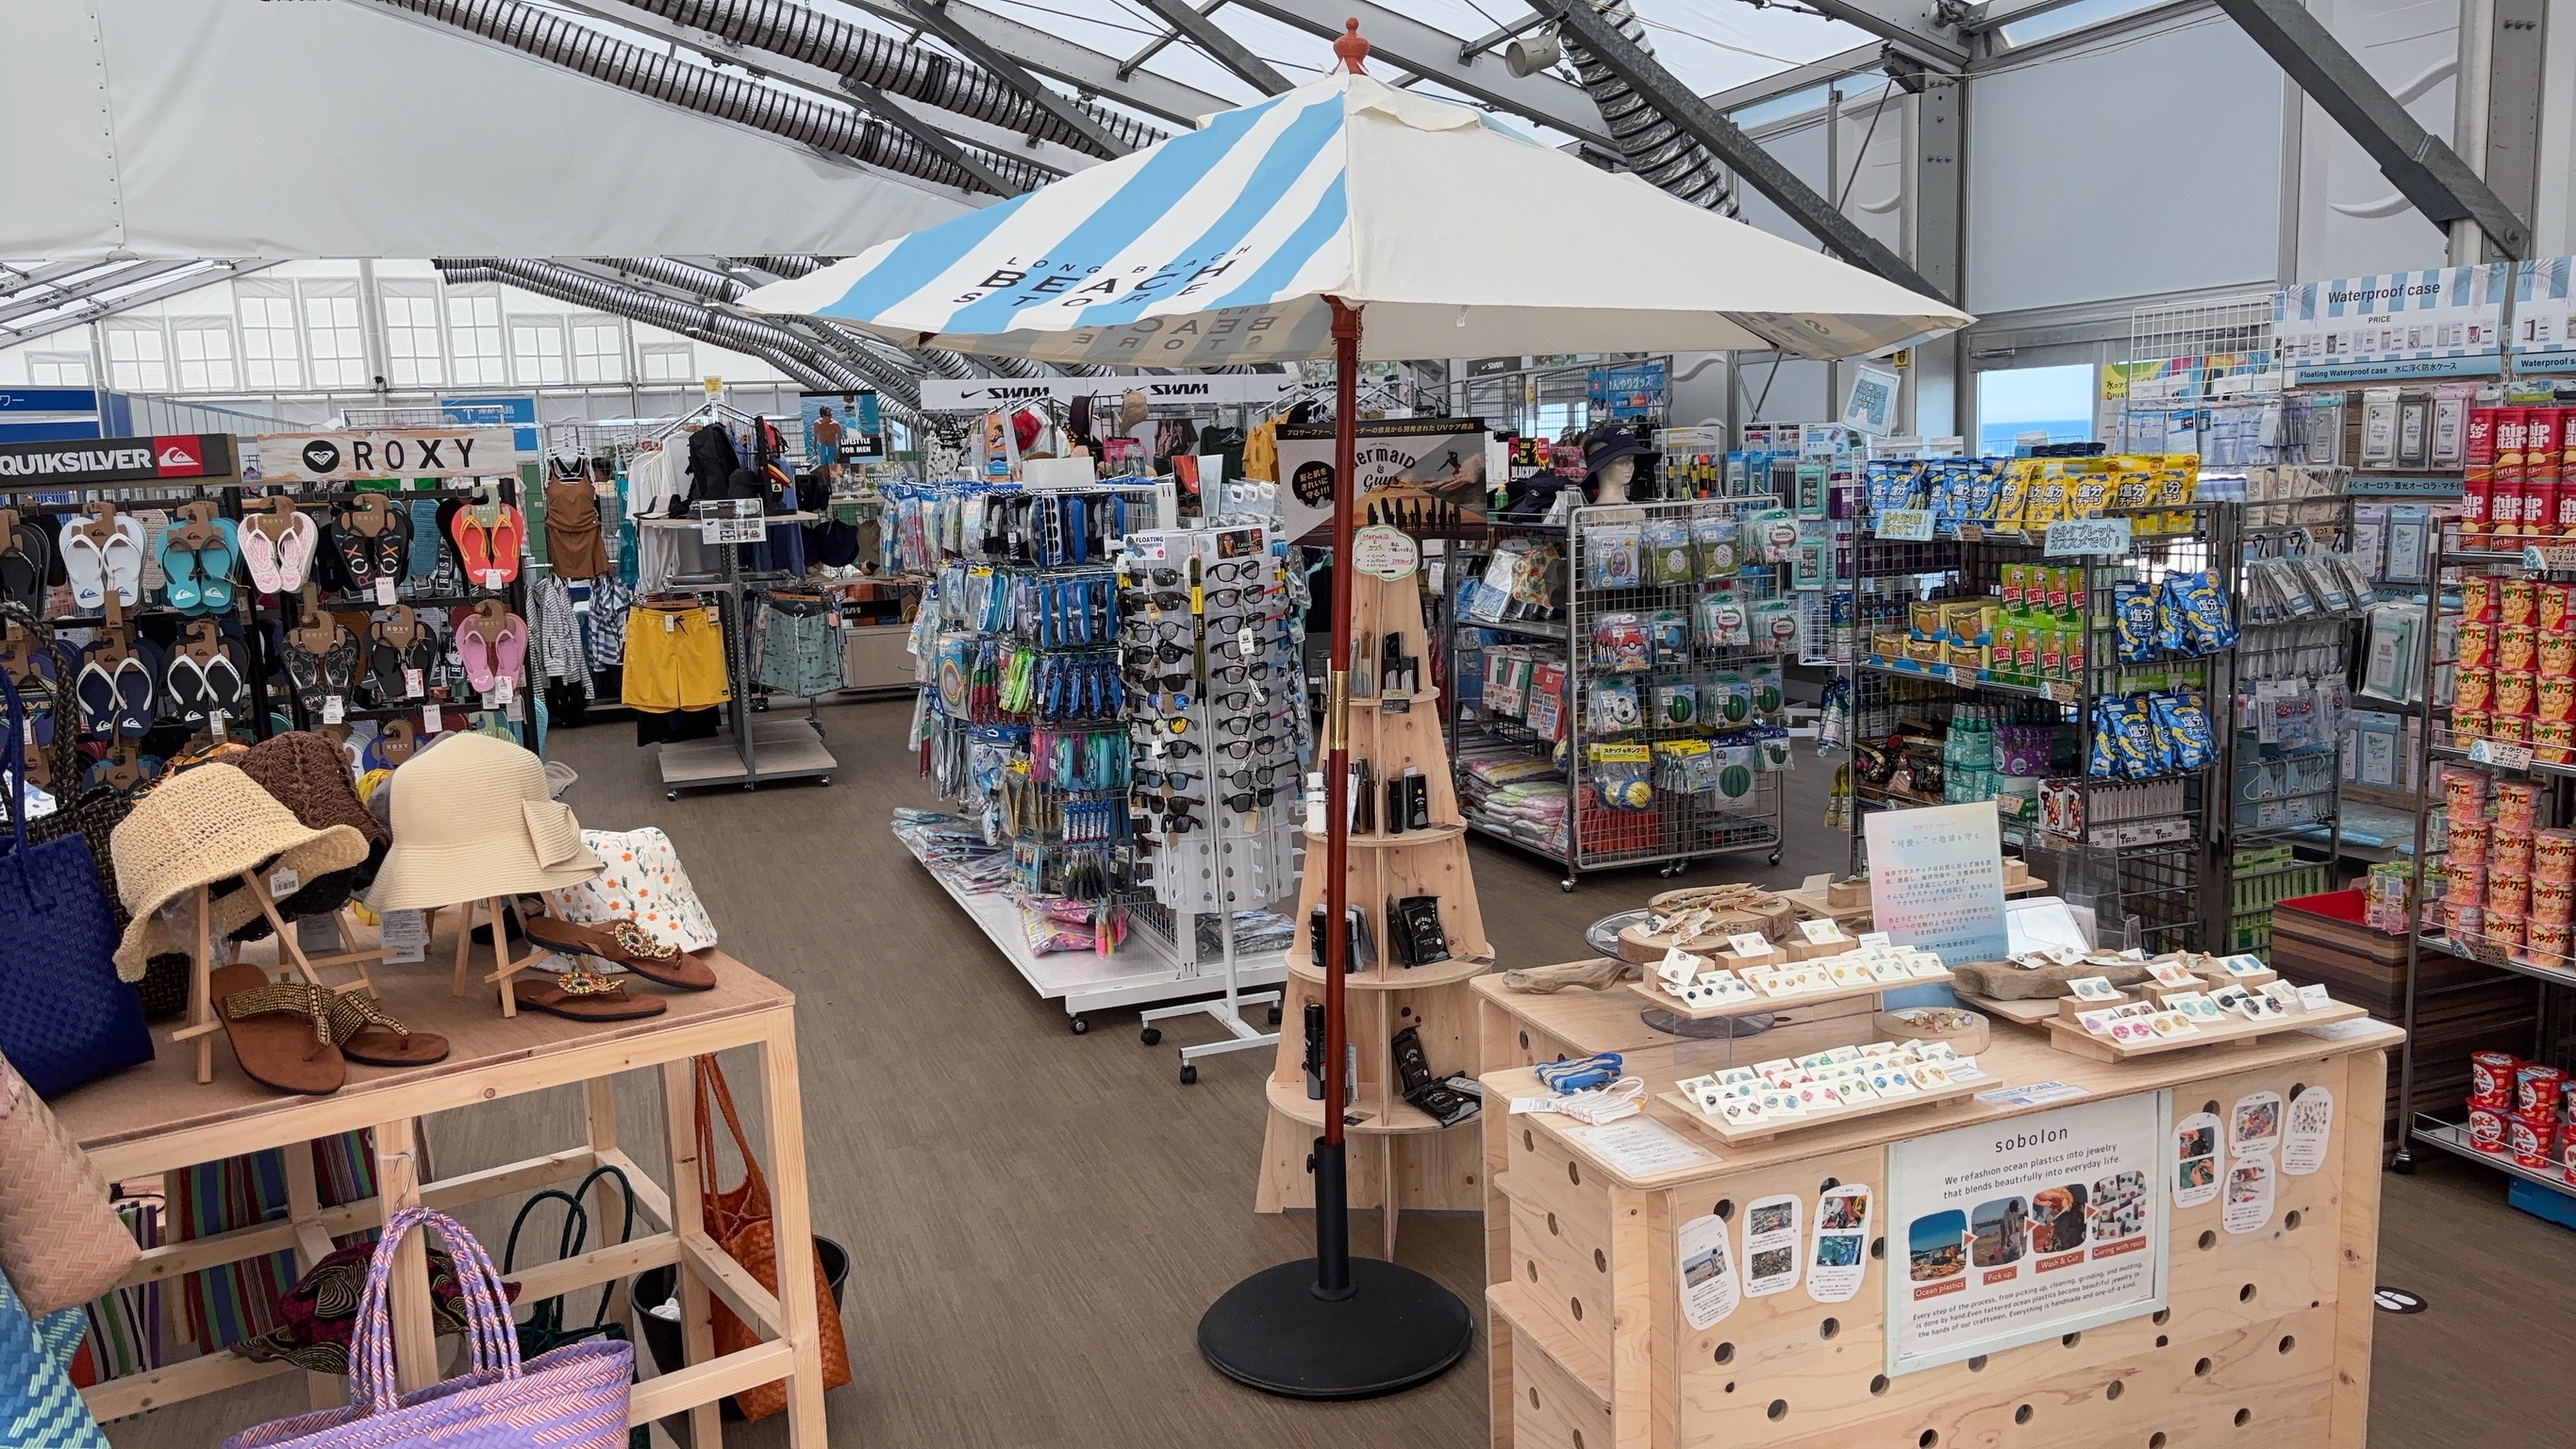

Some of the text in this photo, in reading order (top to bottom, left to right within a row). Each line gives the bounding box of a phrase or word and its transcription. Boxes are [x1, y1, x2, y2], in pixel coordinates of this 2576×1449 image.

[1006, 244, 1253, 275] LONG BEACH
[975, 258, 1238, 295] BEACH
[952, 282, 1208, 308] STORE
[2328, 283, 2441, 305] Waterproof case
[2368, 315, 2391, 325] PRICE
[2394, 362, 2457, 374] 水に浮く防水ケース
[2520, 357, 2568, 368] Waterproof
[2300, 367, 2387, 379] Floating Waterproof case
[987, 386, 1051, 399] SWIM
[1150, 383, 1208, 395] SWIM
[353, 438, 474, 471] ROXY
[0, 448, 153, 476] QUIKSILVER
[1299, 468, 1327, 482] 髪と肌を
[1301, 477, 1329, 491] きれいに
[1363, 475, 1404, 492] Guys
[2076, 484, 2105, 497] 塩分
[2119, 483, 2147, 496] 塩分
[1971, 485, 1989, 497] 塩分
[2076, 497, 2102, 507] チャージ
[2119, 496, 2145, 506] チャージ
[2003, 588, 2021, 600] PRETZ
[2025, 589, 2045, 601] PRETZ
[2048, 591, 2067, 605] PRETZ
[2196, 599, 2219, 612] 塩分
[2129, 608, 2154, 622] 塩分
[2130, 622, 2153, 630] チャージ
[1994, 648, 2012, 659] PRETZ
[2017, 651, 2035, 663] PRETZ
[2042, 654, 2060, 666] PRETZ
[2181, 715, 2204, 729] 塩分
[2128, 724, 2151, 739] 塩分
[2494, 744, 2530, 756] じゃがりこ
[2499, 751, 2520, 760] チーズ
[1995, 1127, 2069, 1153] sobolon
[1944, 1142, 2118, 1186] We refashion ocean plastics into jewelry
[1943, 1154, 2121, 1199] that blends beautifully into everyday life.
[2093, 1240, 2145, 1258] Curing with resin
[2041, 1259, 2058, 1269] Wash
[2068, 1254, 2079, 1263] Cut
[1987, 1270, 2012, 1281] Pick up
[1915, 1280, 1964, 1297] Ocean plastics
[1913, 1312, 1931, 1321] Every
[1933, 1308, 1947, 1317] step
[1970, 1298, 1997, 1309] process,
[2016, 1286, 2037, 1298] picking
[1923, 1319, 1939, 1328] done
[1940, 1316, 1949, 1324] by
[1984, 1303, 2012, 1314] tattered
[2013, 1298, 2031, 1307] ocean
[2032, 1292, 2056, 1304] plastics
[2057, 1286, 2081, 1296] become
[2082, 1278, 2110, 1291] beautiful
[2111, 1274, 2133, 1285] jewelry
[1931, 1326, 1951, 1336] hands
[1952, 1323, 1959, 1331] of
[2009, 1304, 2043, 1318] Everything
[2051, 1295, 2081, 1307] handmade
